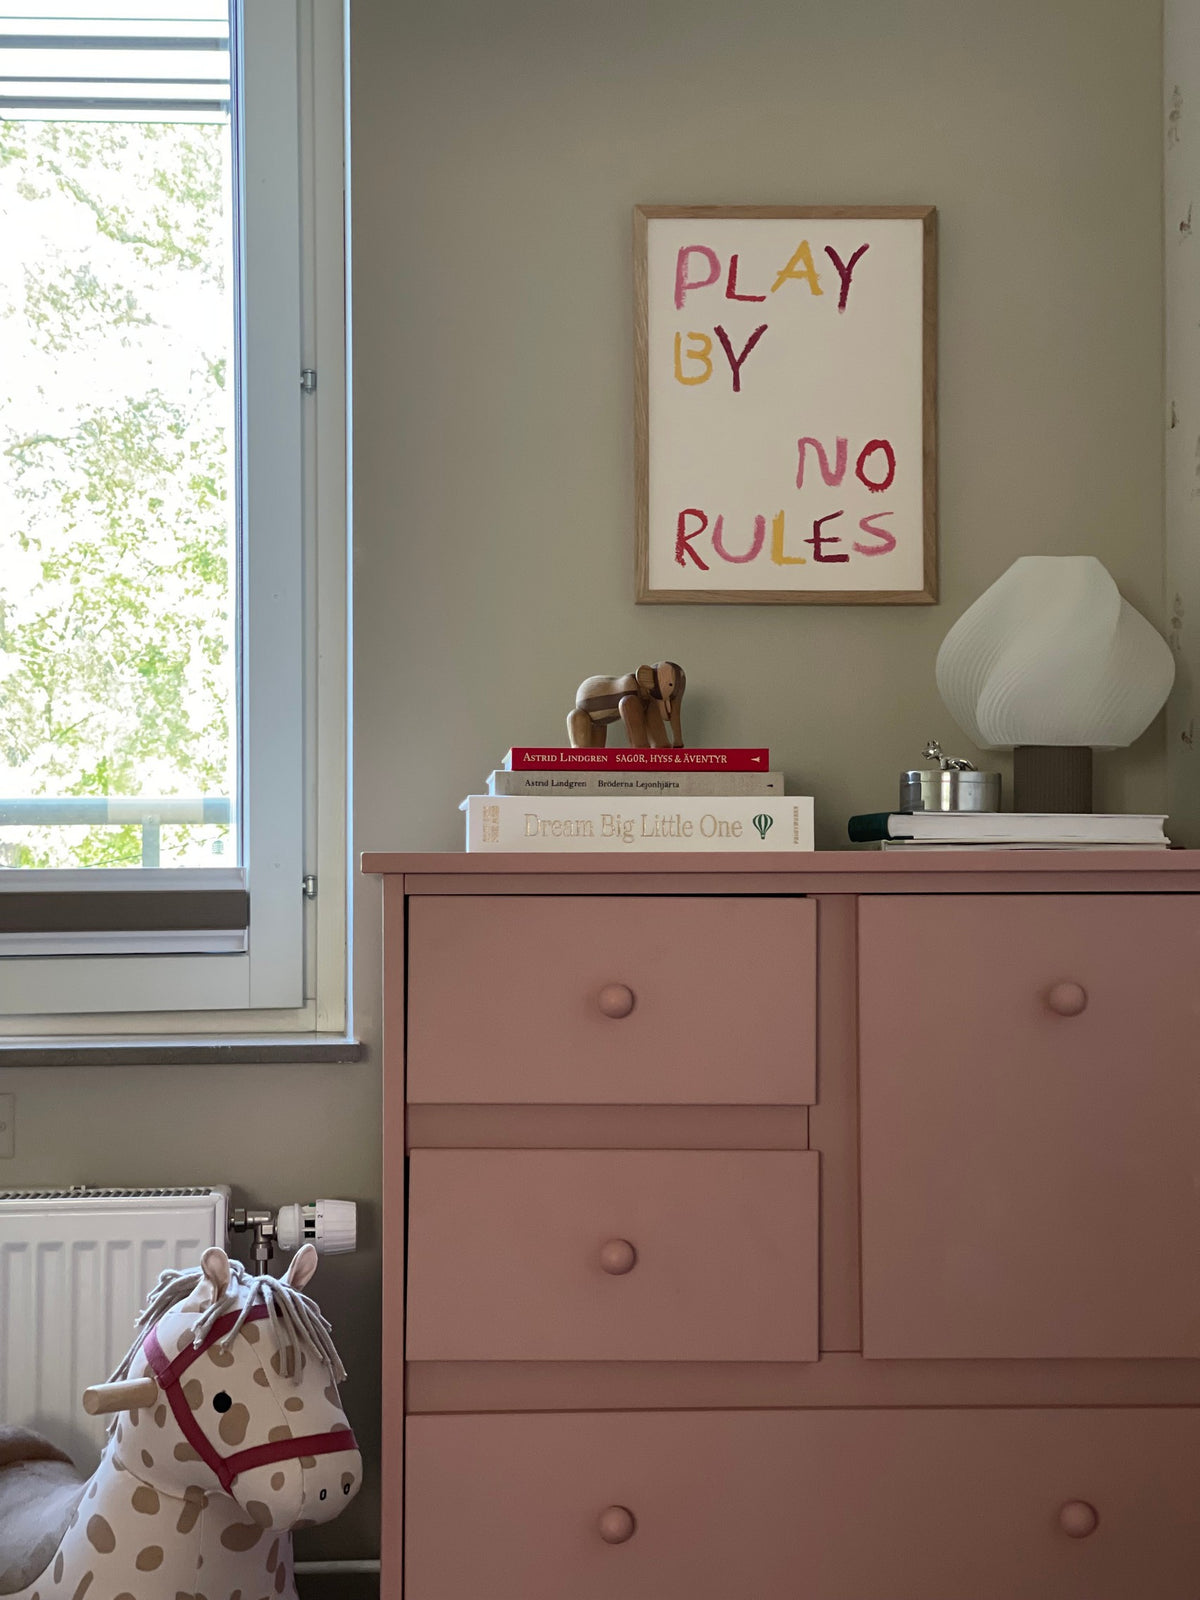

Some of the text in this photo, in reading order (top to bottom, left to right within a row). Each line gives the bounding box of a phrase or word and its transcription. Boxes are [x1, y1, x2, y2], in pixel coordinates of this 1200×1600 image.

[674, 240, 870, 313] PLAY
[674, 324, 768, 392] BY
[796, 436, 896, 492] NO
[675, 508, 897, 570] RULES
[523, 752, 728, 764] ASTRID LINDGREN SAGOR, HYSS & ÄVENTYR
[525, 779, 549, 787] Astrid
[551, 779, 587, 789] Lindgren
[636, 780, 680, 790] Lejonhjärta
[524, 813, 595, 838] Dream
[600, 814, 635, 844] Big
[641, 814, 693, 838] Little
[700, 814, 743, 838] One
